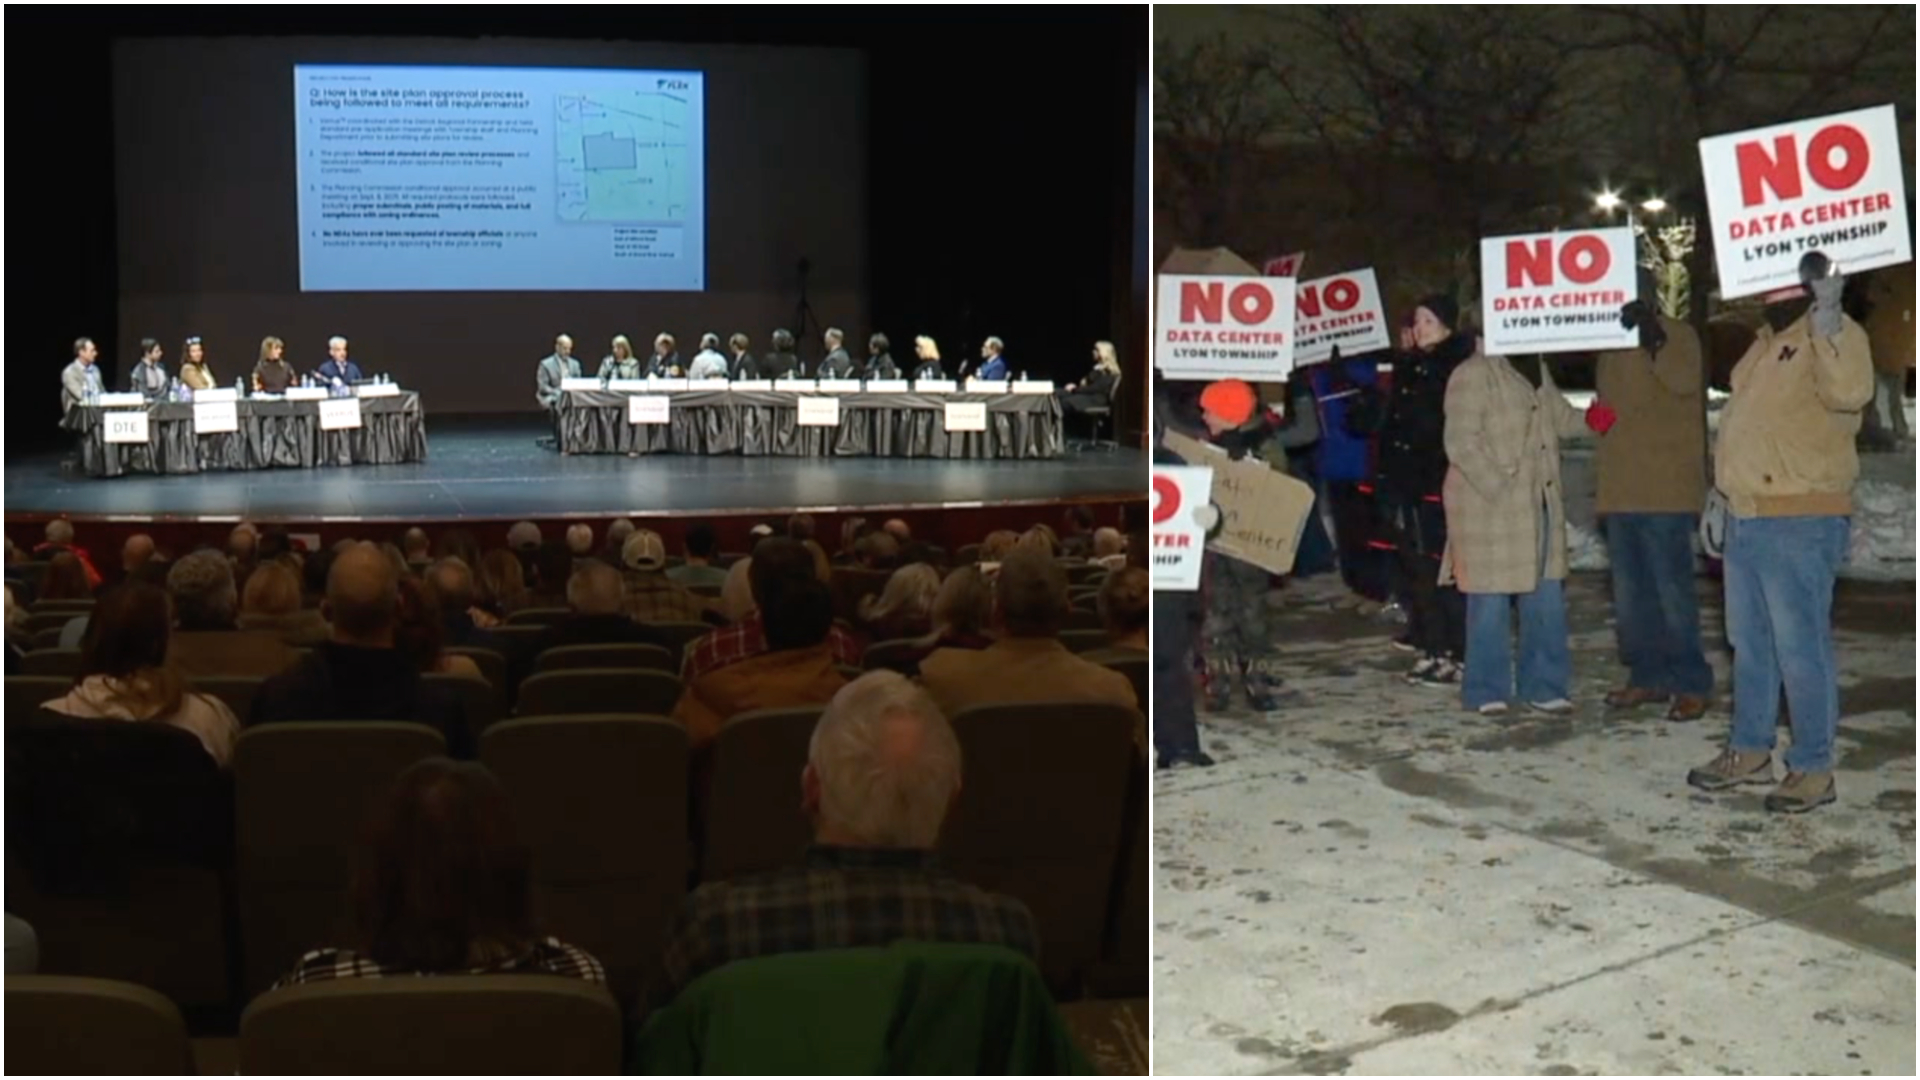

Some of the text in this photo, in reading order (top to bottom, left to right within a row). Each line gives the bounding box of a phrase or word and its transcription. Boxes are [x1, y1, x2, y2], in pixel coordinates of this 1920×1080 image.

[323, 88, 346, 98] How
[348, 88, 358, 98] is
[360, 88, 378, 98] the
[381, 89, 400, 99] site
[402, 89, 426, 100] plan
[429, 90, 478, 100] approval
[481, 90, 524, 100] process
[310, 98, 530, 110] being followed to meet all requirements?
[1735, 124, 1870, 208] NO
[1729, 193, 1892, 240] DATA CENTER
[1744, 221, 1887, 262] LYON TOWNSHIP
[1505, 234, 1611, 289] NO
[1179, 282, 1274, 325] NO
[1494, 290, 1625, 312] DATA CENTER
[1320, 310, 1375, 330] CENTER
[1503, 312, 1620, 328] LYON TOWNSHIP
[1167, 330, 1283, 344] DATA CENTER
[1318, 325, 1374, 343] TOWNSHIP
[1174, 348, 1279, 359] LYON TOWNSHIP
[113, 421, 138, 434] DTE
